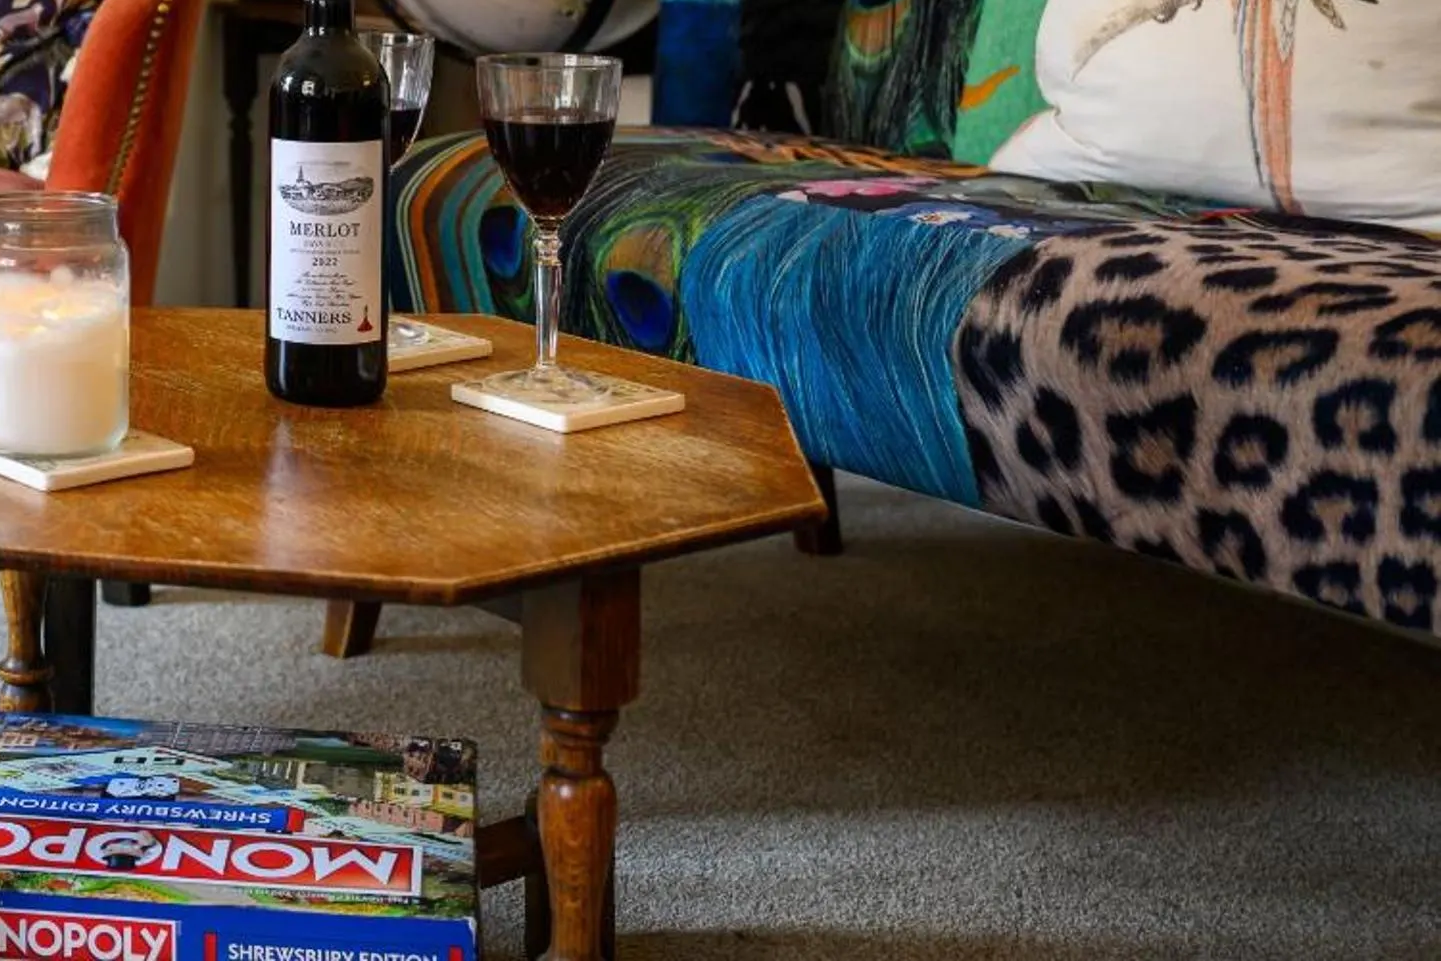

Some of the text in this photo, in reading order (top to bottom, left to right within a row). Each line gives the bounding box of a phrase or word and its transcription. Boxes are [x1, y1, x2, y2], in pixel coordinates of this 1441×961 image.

[290, 221, 361, 238] MERLOT
[276, 307, 352, 325] TANNERS
[103, 800, 272, 825] SHREWSBURY
[227, 943, 355, 961] SHREWSBURY
